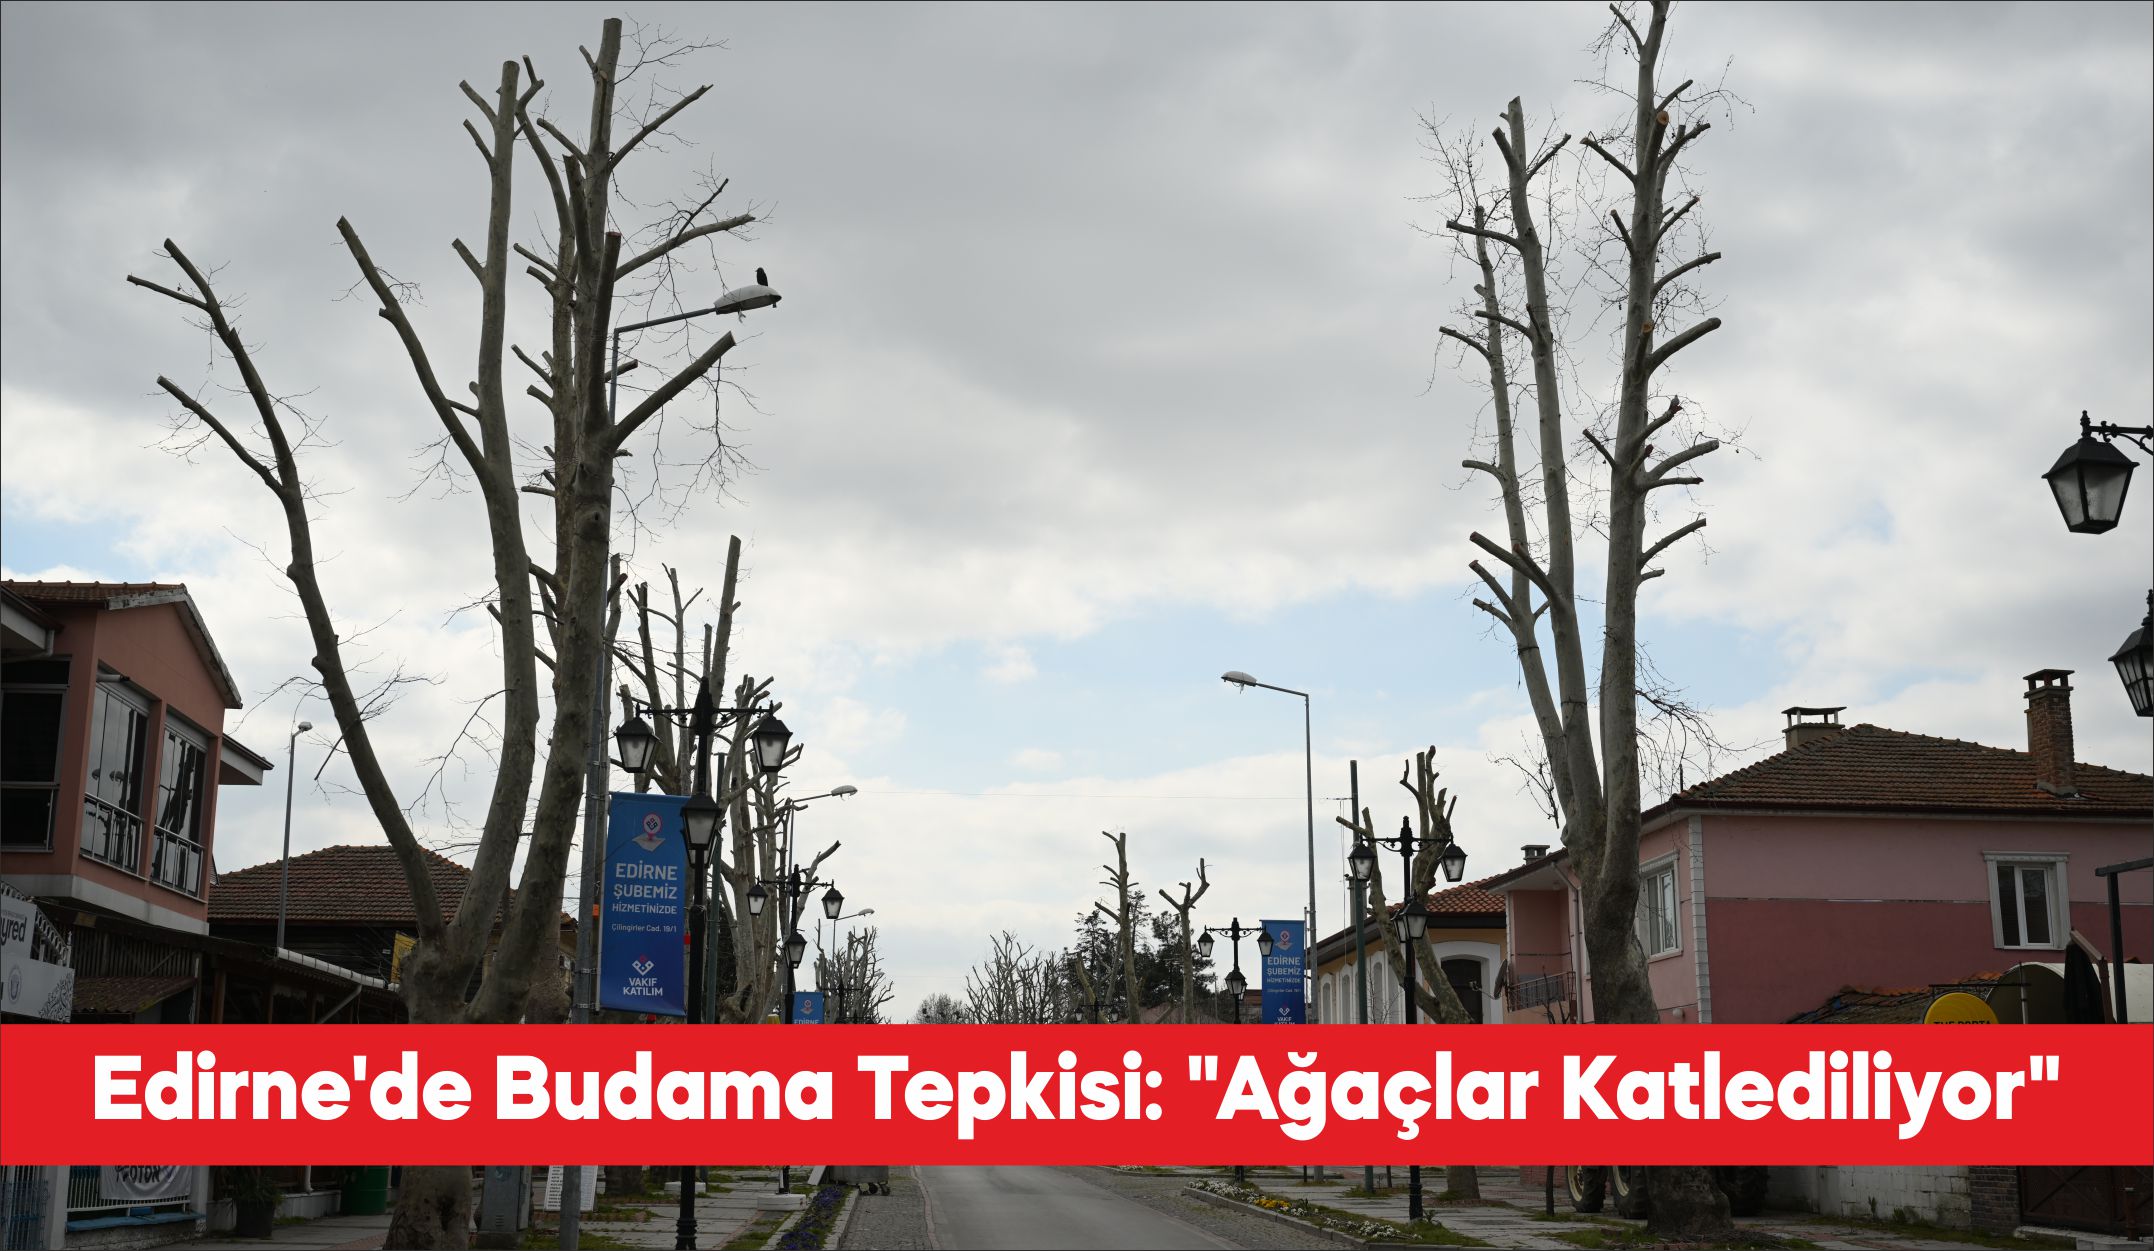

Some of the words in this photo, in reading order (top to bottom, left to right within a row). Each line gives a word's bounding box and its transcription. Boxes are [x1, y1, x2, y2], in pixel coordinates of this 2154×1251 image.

[615, 860, 678, 880] EDİRNE
[613, 883, 678, 900] ŞUBEMİZ
[612, 901, 677, 914] HİZMETİNİZDE
[646, 924, 662, 933] Cad.
[1267, 955, 1301, 965] EDİRNE
[1266, 966, 1301, 976] ŞUBEMİZ
[628, 977, 658, 987] VAKIF
[623, 986, 664, 997] KATILIM
